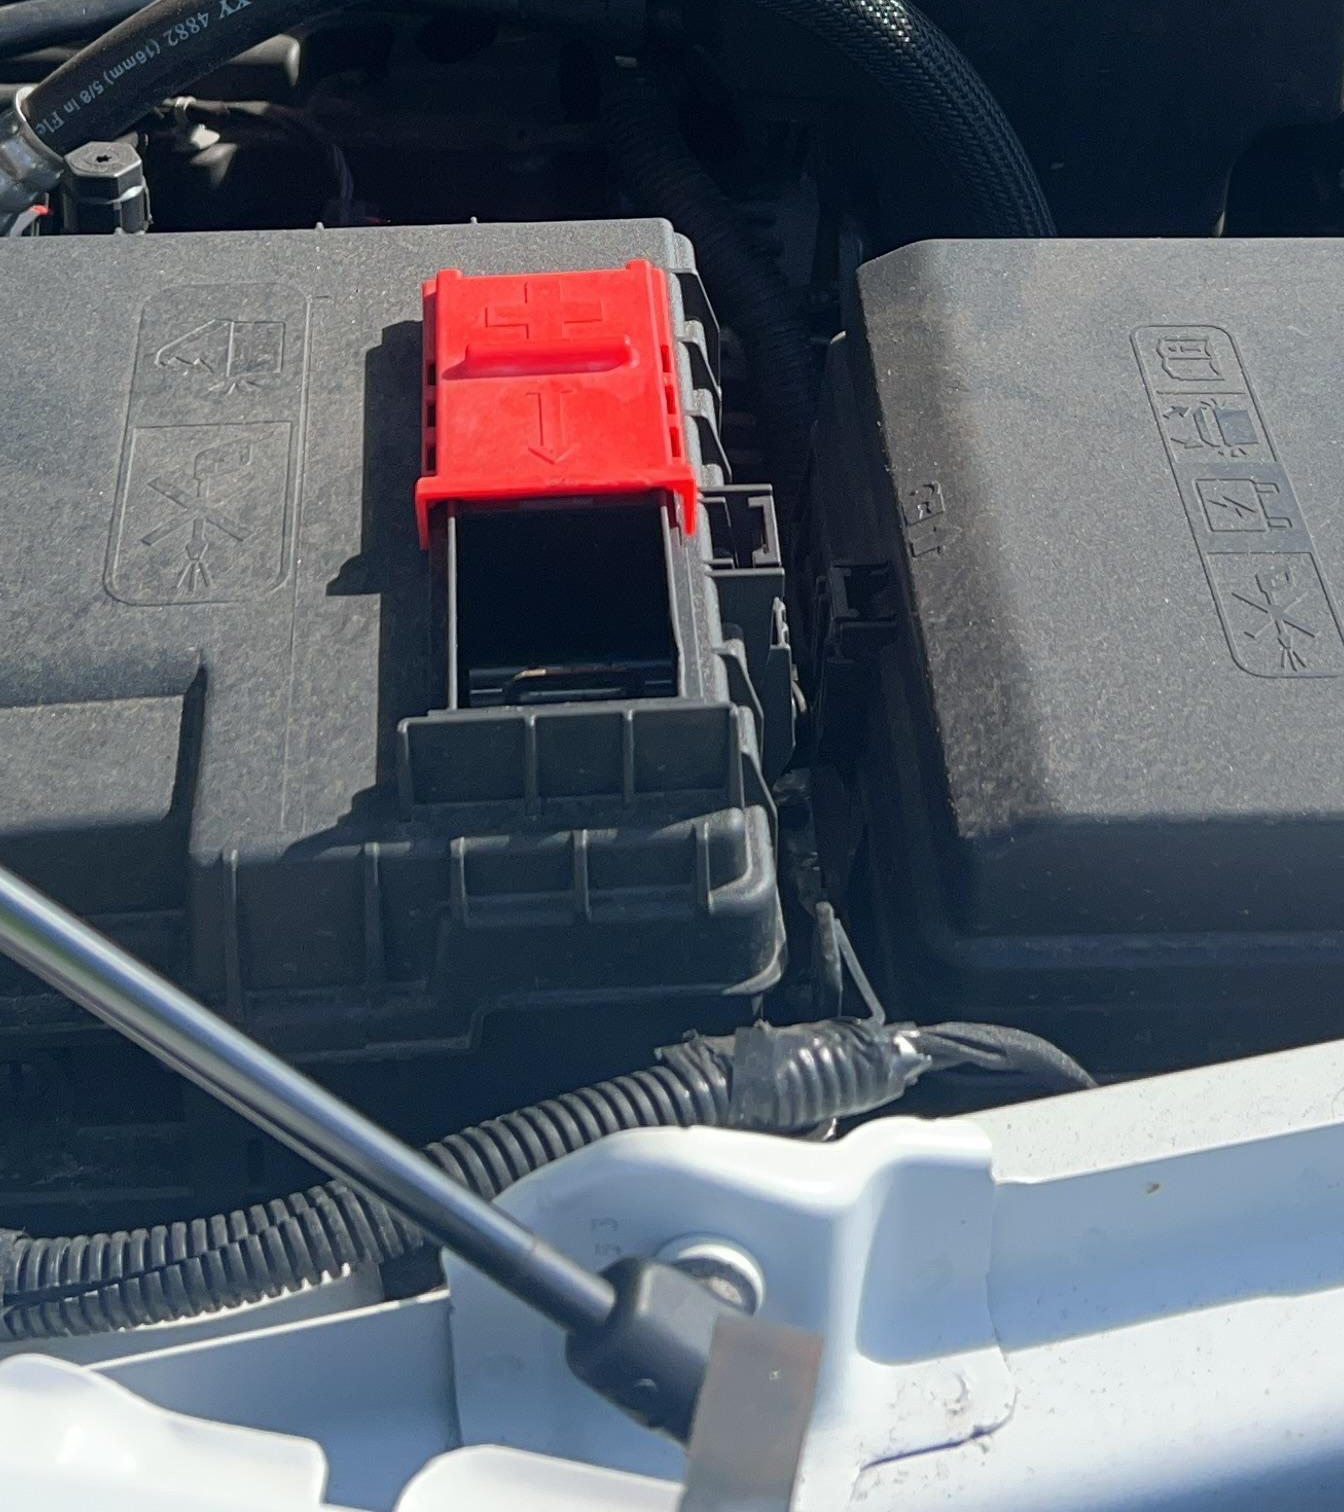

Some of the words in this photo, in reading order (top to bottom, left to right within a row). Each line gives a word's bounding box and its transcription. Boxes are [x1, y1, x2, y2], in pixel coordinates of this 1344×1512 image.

[163, 11, 210, 47] 4882
[103, 38, 161, 85] (16mm)
[63, 97, 81, 113] in
[79, 80, 104, 104] 5/8
